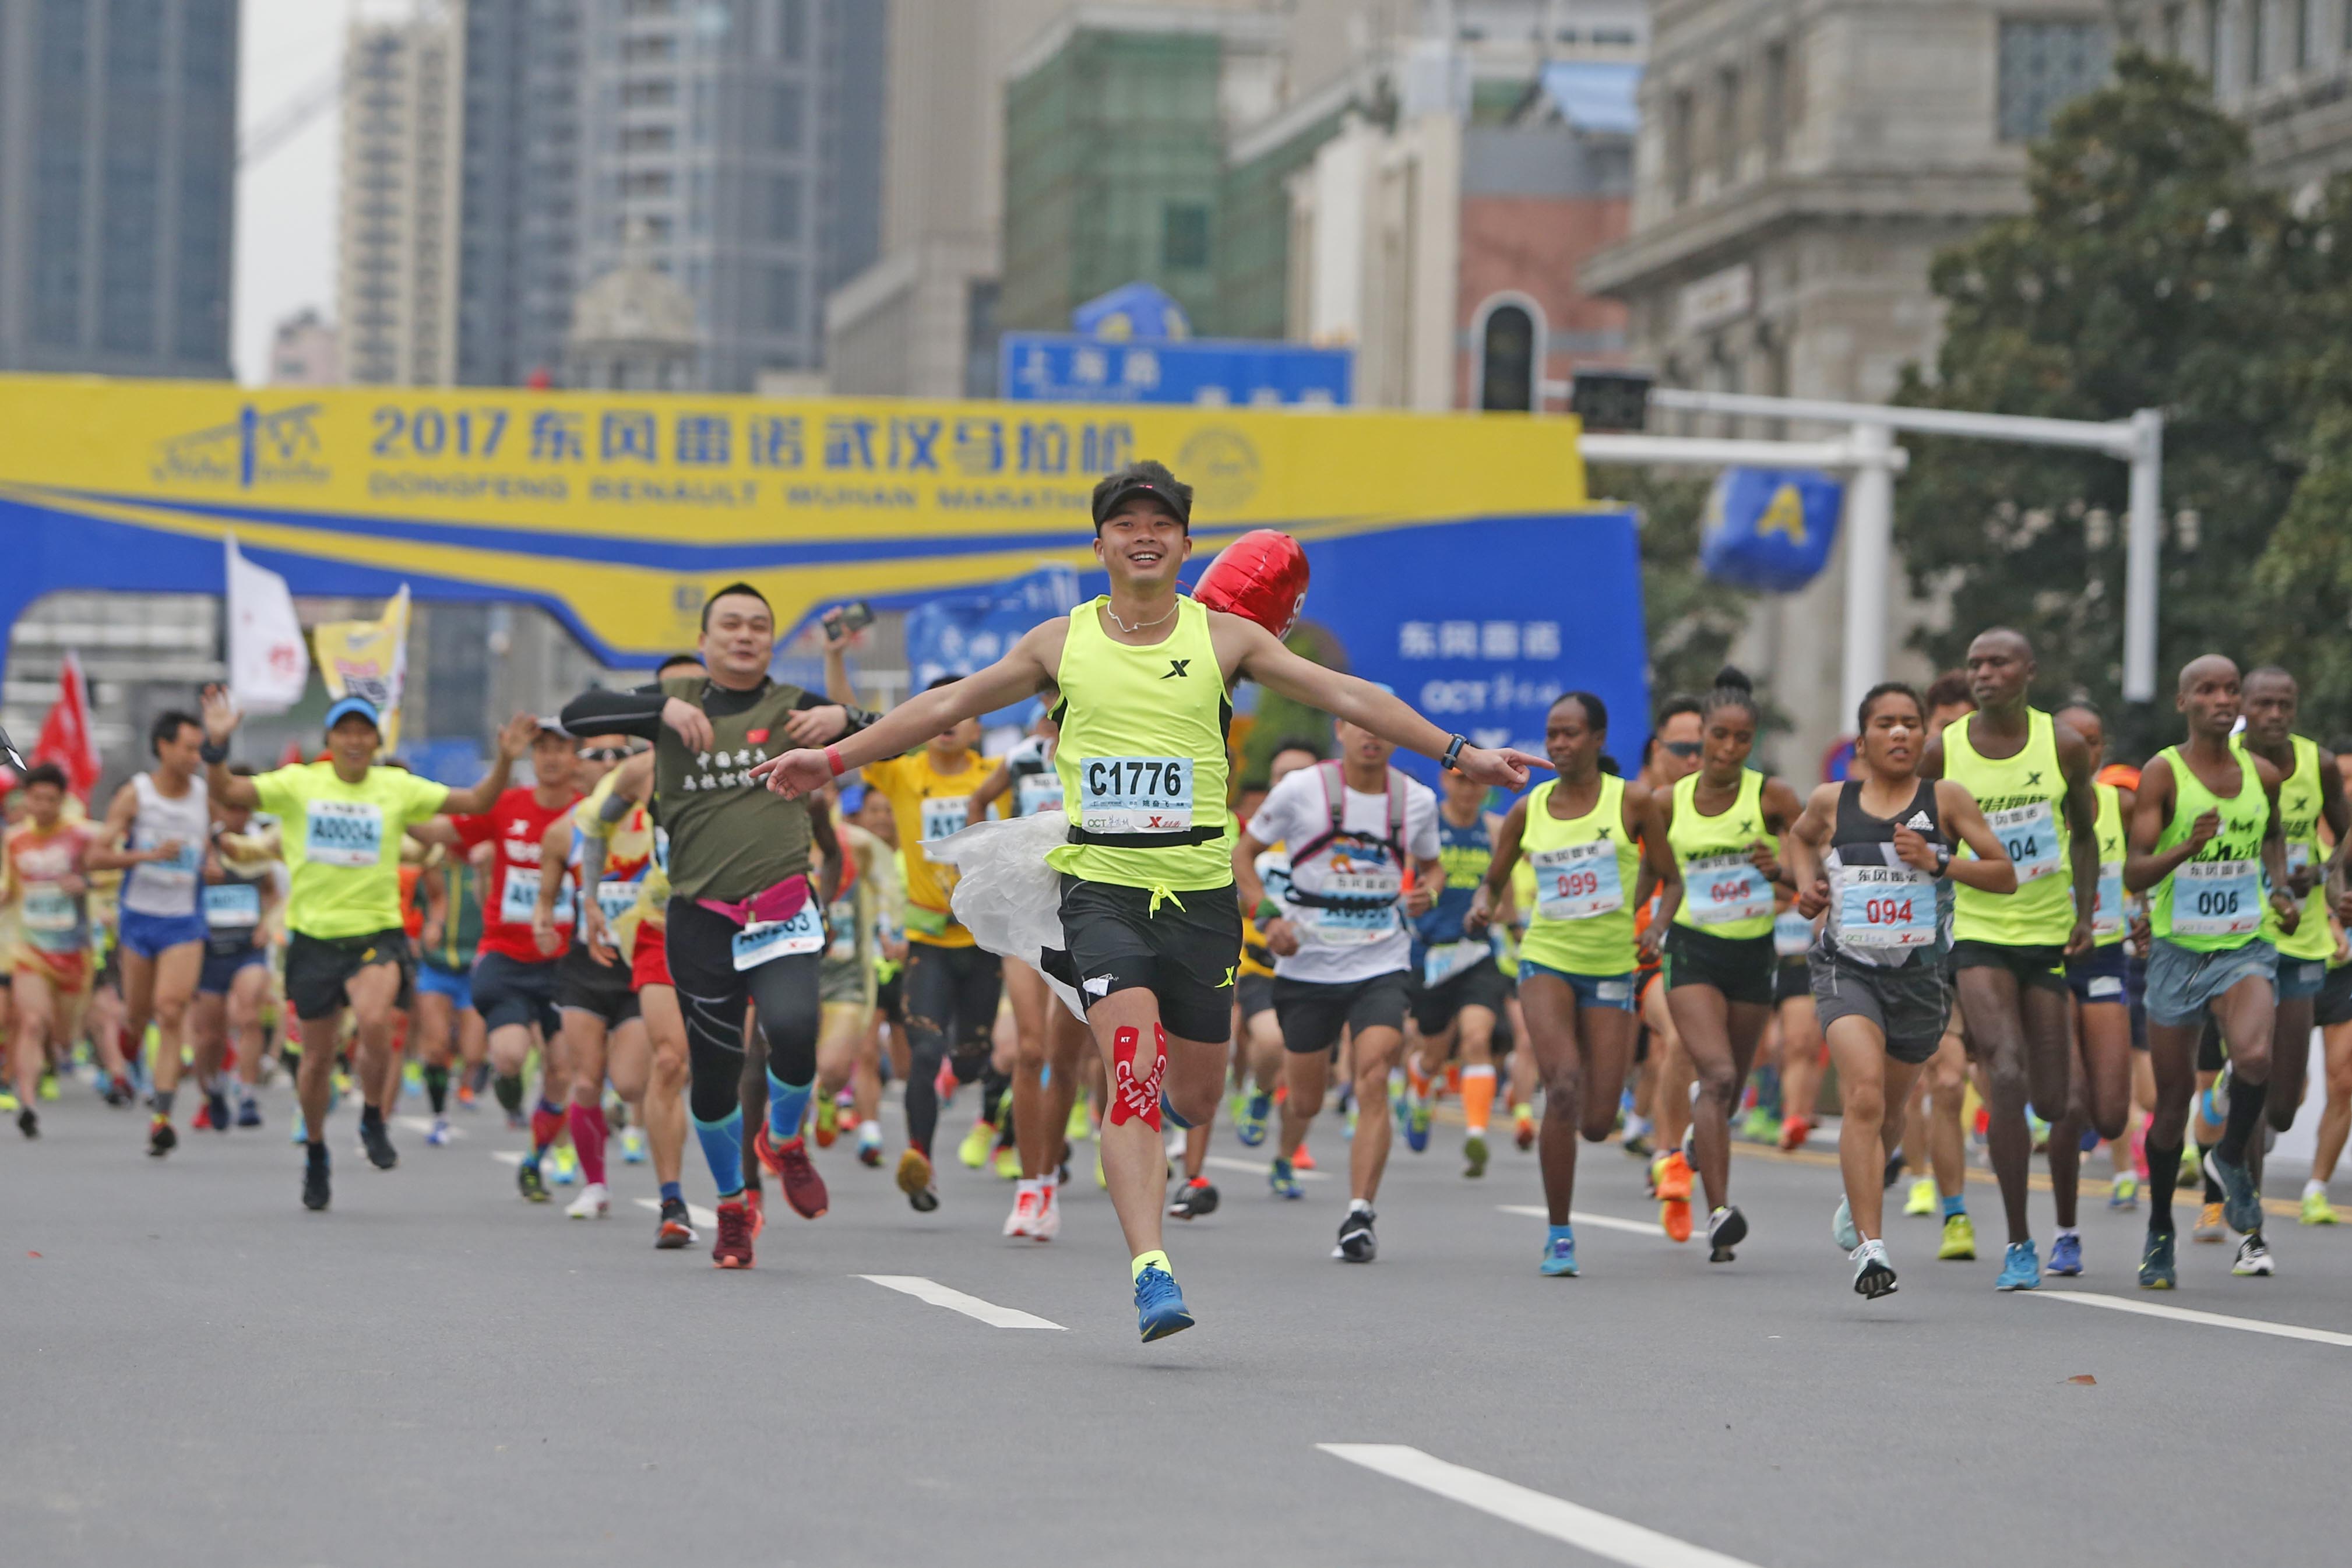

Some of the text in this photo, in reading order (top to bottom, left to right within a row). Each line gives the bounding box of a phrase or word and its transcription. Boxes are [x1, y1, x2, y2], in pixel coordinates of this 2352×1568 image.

[373, 407, 508, 460] 2017
[1089, 762, 1181, 796] C1776
[1088, 819, 1106, 827] OCT
[1906, 820, 1934, 831] adidas
[1558, 871, 1597, 897] 099
[1867, 899, 1913, 925] 094
[2199, 890, 2239, 915] 006
